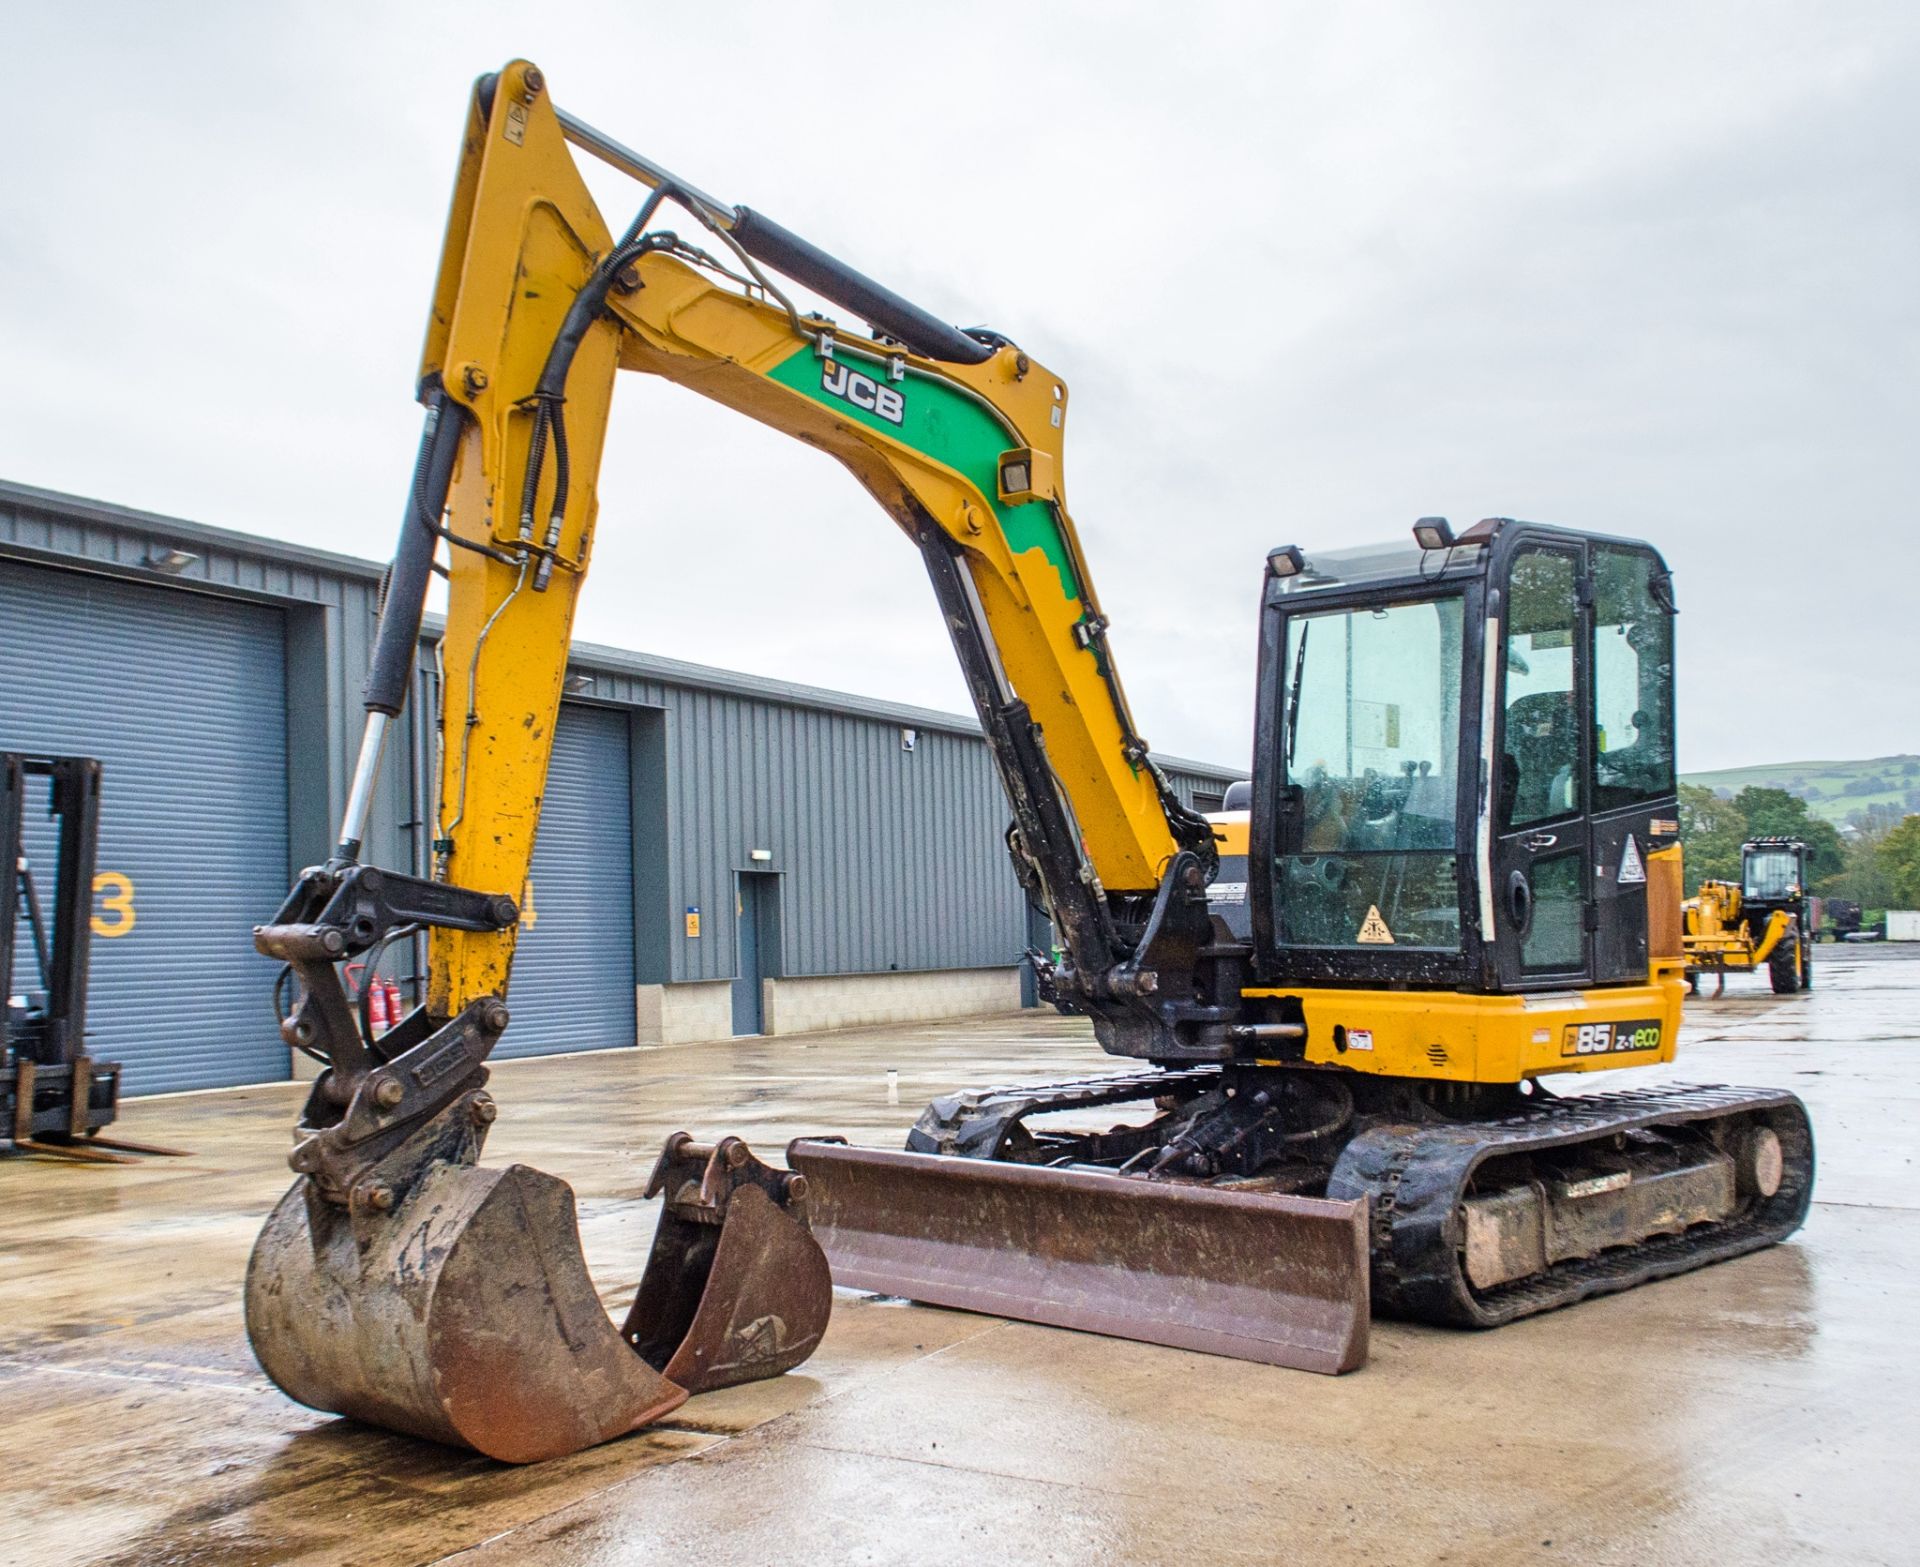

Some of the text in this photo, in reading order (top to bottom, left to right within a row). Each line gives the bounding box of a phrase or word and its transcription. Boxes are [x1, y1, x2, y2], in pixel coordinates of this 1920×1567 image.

[823, 360, 904, 423] JCB
[90, 872, 136, 937] 3
[1577, 1024, 1611, 1053] 85
